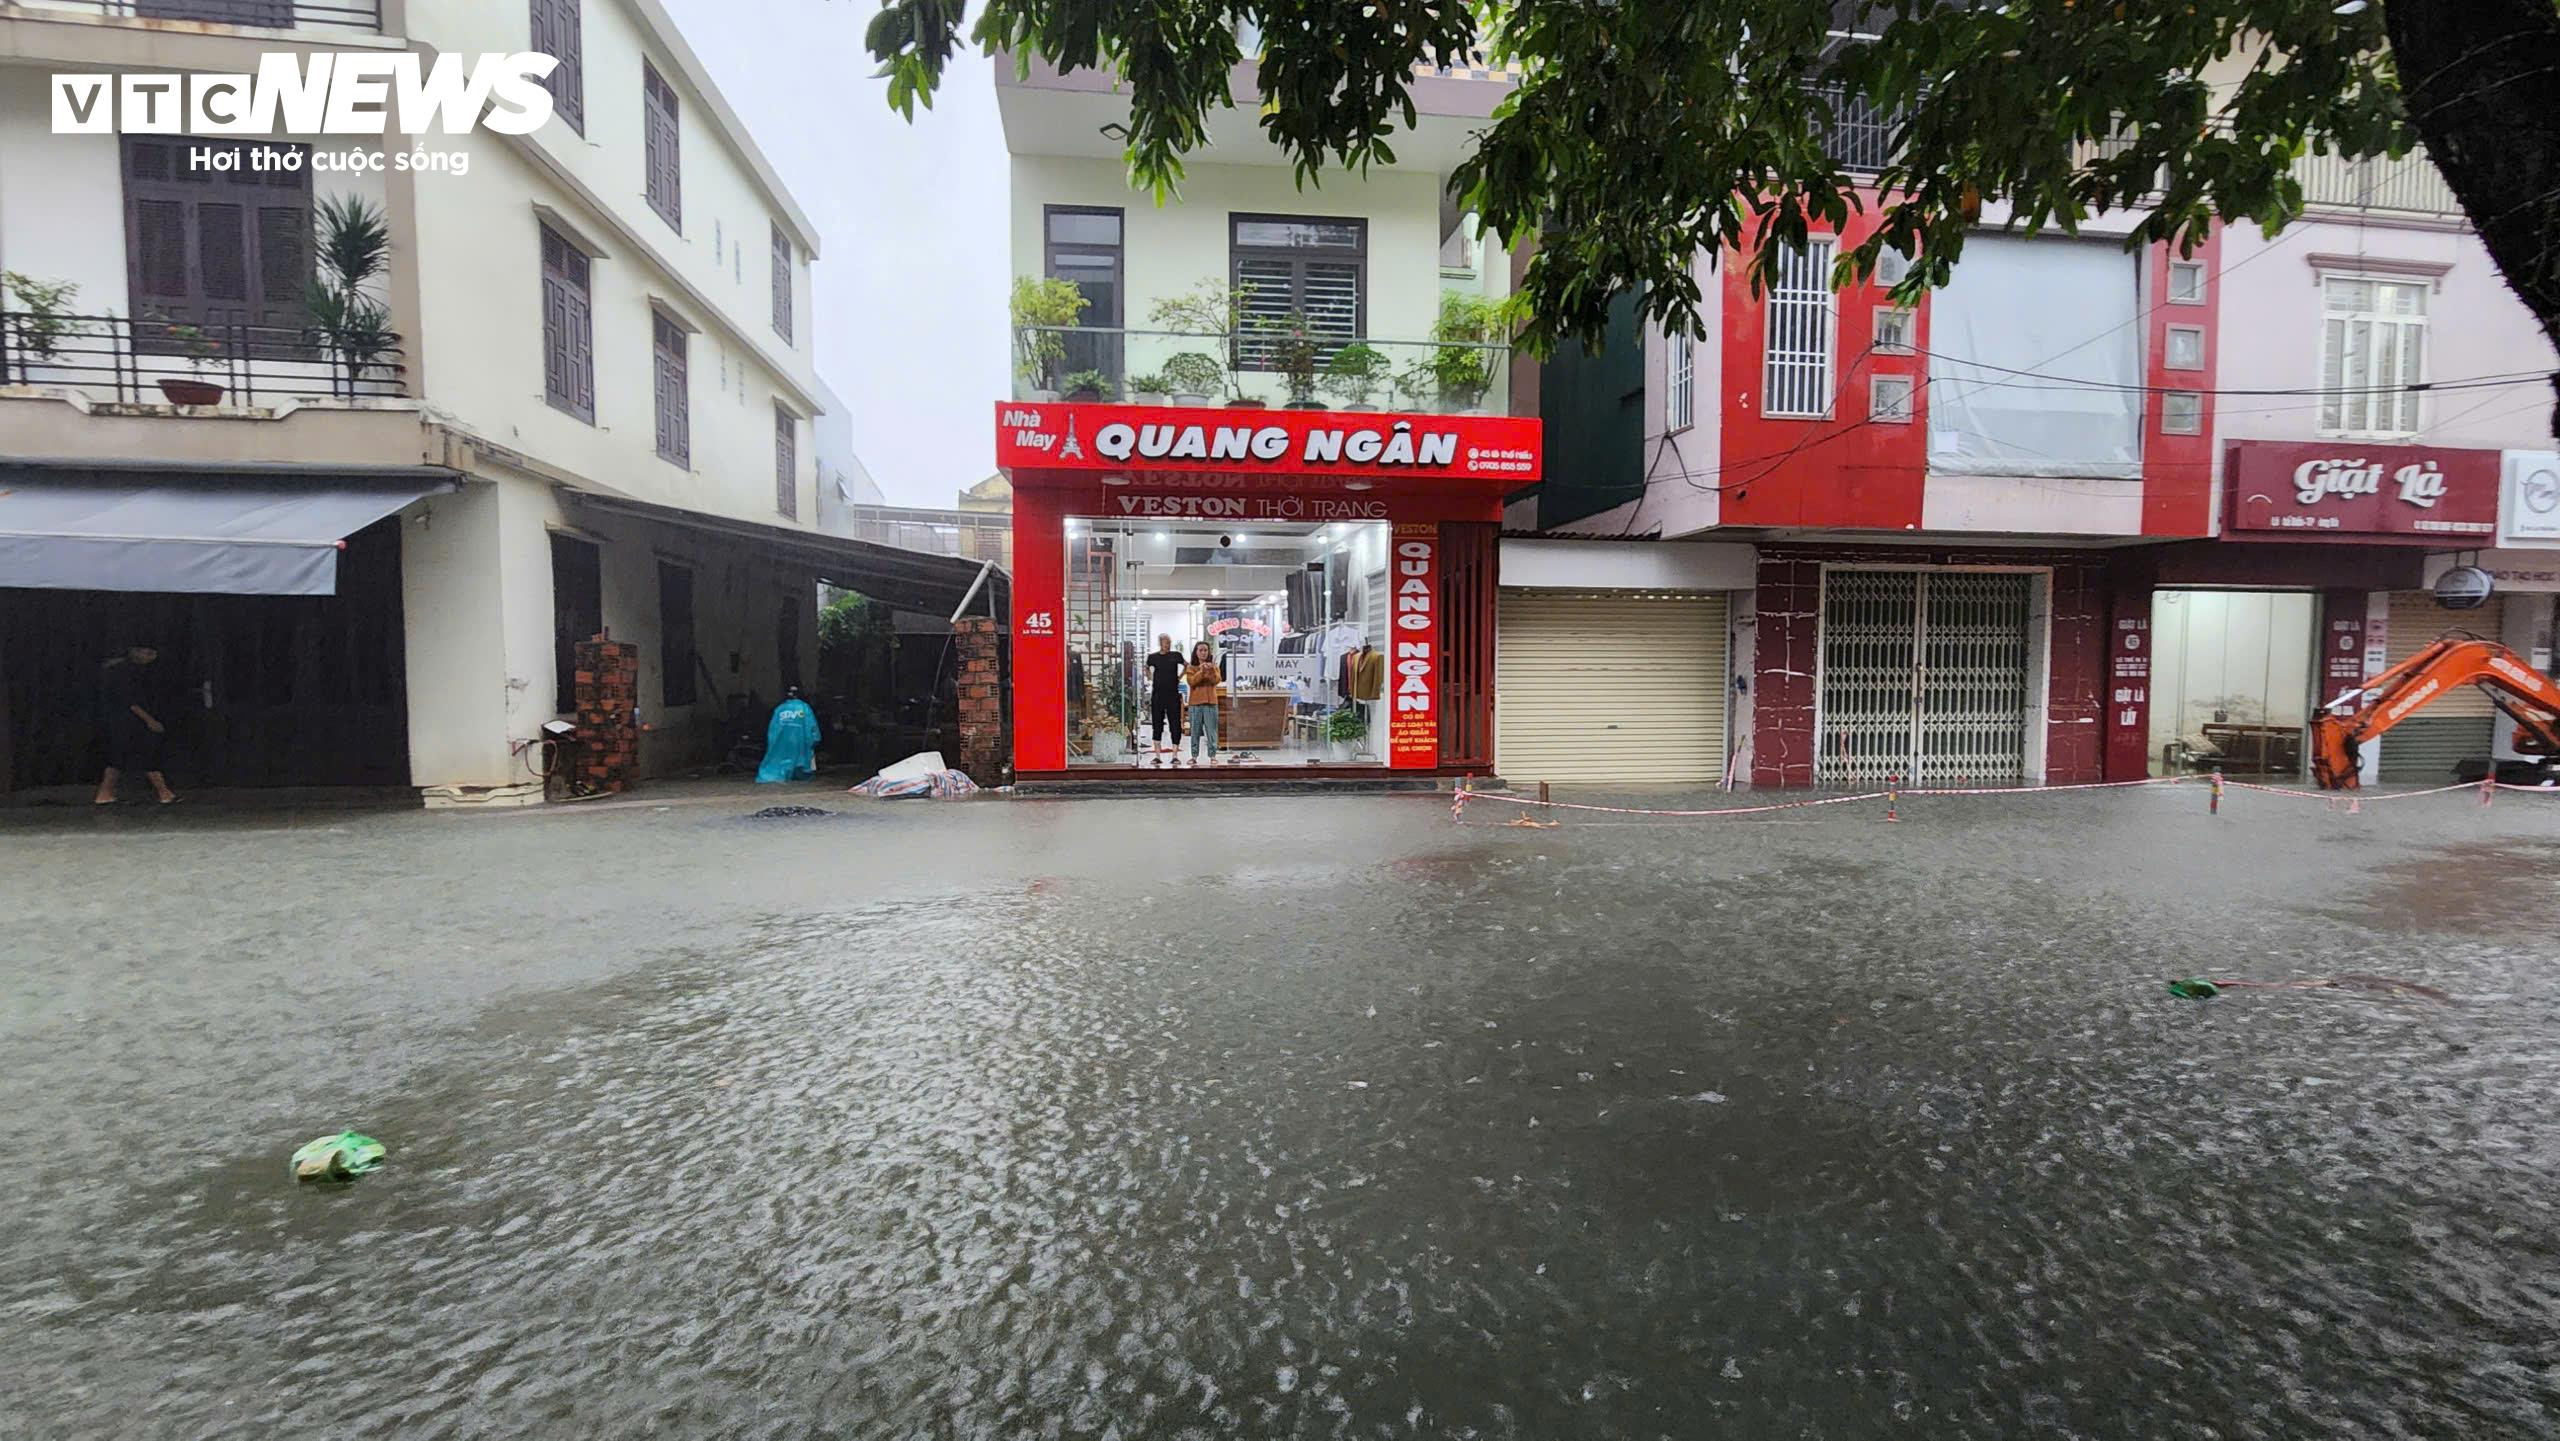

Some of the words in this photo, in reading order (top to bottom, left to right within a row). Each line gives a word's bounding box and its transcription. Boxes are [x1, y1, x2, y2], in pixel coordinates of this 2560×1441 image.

[1003, 410, 1041, 427] Nhà
[1016, 430, 1056, 451] May
[1095, 423, 1289, 462] QUANG
[1303, 420, 1458, 465] NGÂN
[2293, 457, 2384, 505] Giặt
[2393, 460, 2448, 508] Là
[1117, 496, 1246, 516] VESTON
[1256, 496, 1303, 517] THỜI
[1311, 500, 1388, 519] TRANG
[1393, 523, 1437, 535] VESTON
[1397, 542, 1431, 630] QUANG
[1025, 612, 1052, 628] 45
[1275, 660, 1299, 669] MAY
[1397, 642, 1432, 711] NGÂN
